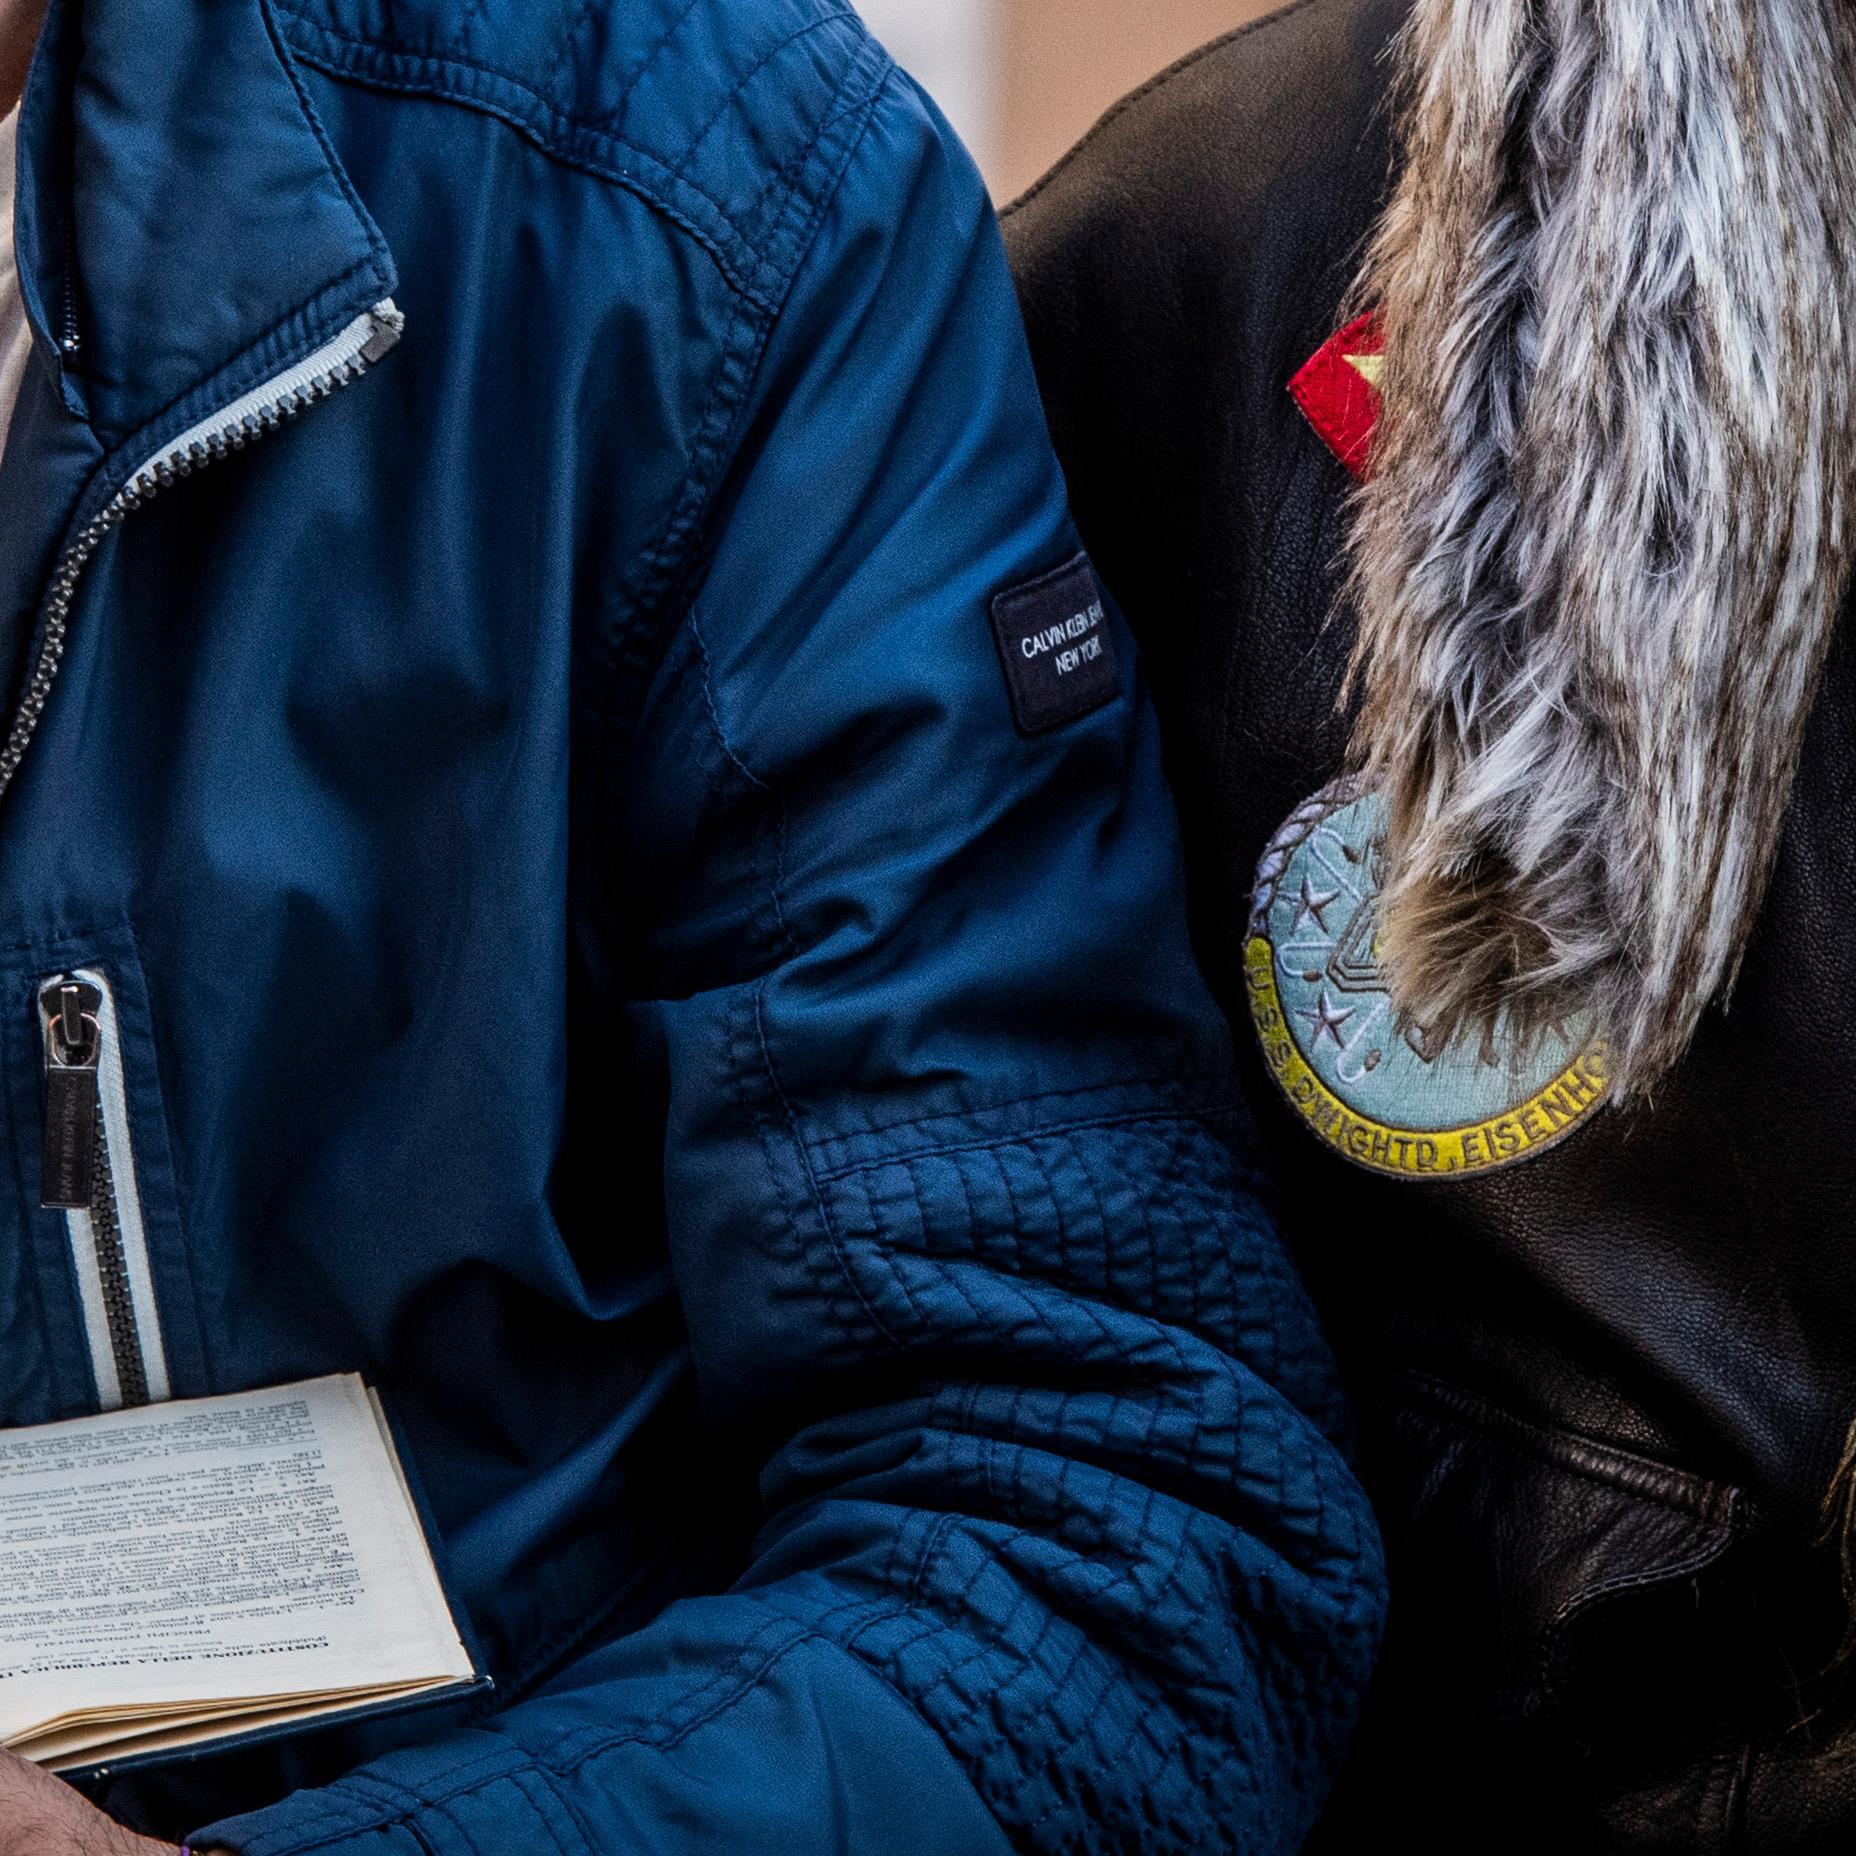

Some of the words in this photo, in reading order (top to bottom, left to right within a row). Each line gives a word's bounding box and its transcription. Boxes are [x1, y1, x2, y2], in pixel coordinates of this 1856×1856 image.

[1021, 623, 1066, 659] CALVIN
[1065, 610, 1090, 639] KLEIN
[1055, 647, 1080, 676] NEW
